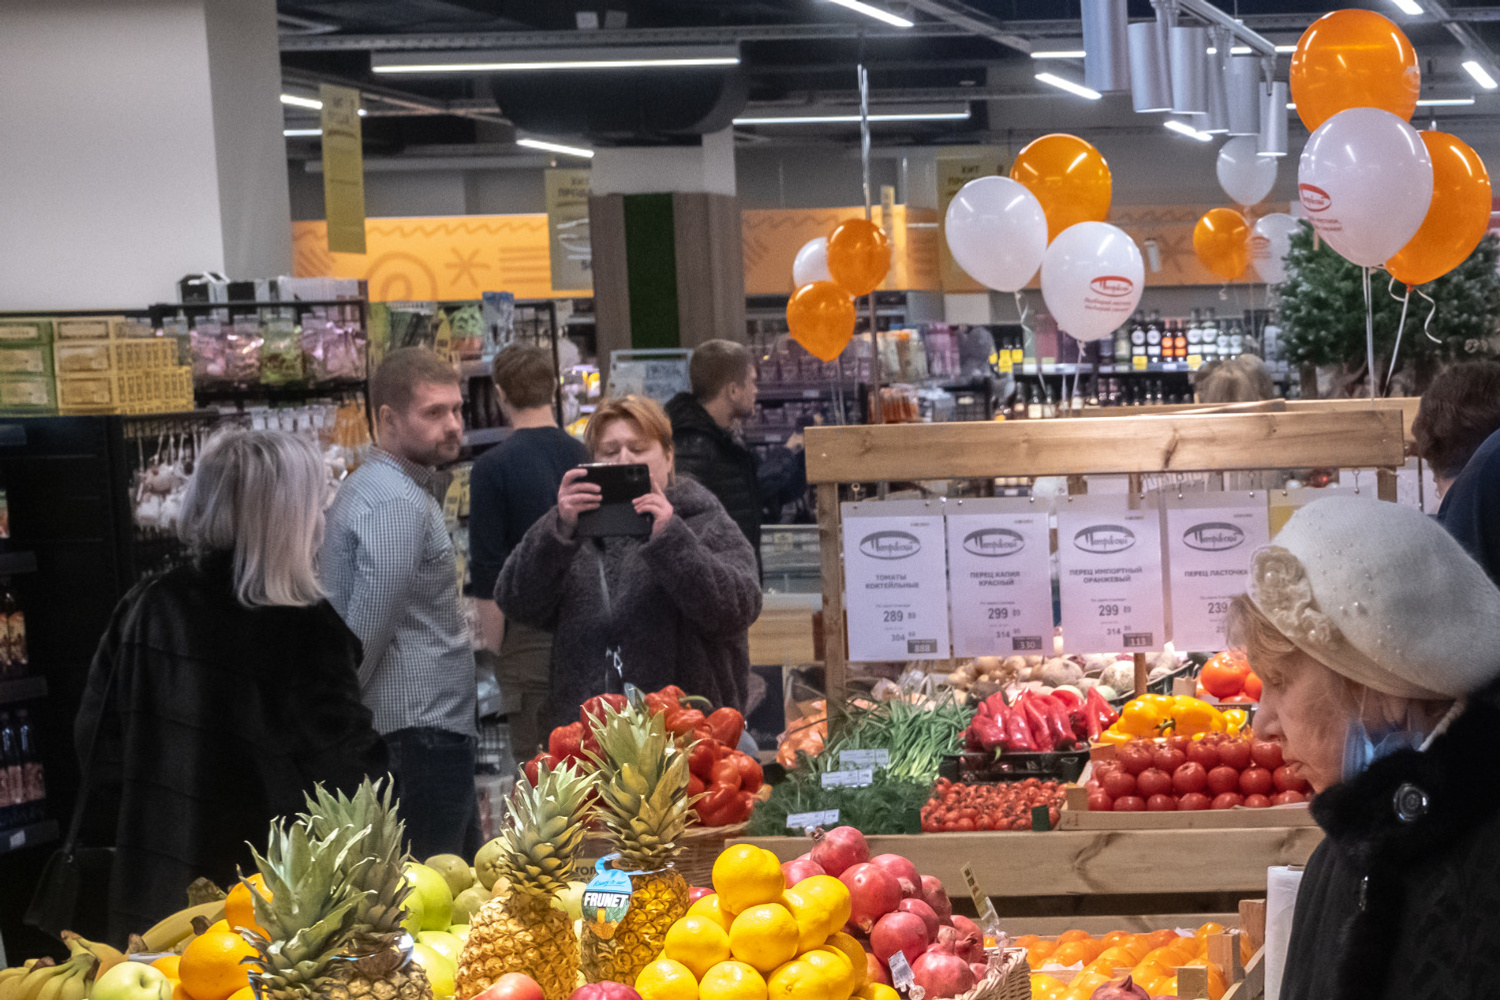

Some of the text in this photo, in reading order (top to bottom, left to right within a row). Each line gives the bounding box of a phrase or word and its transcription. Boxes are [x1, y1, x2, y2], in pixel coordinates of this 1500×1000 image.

[1069, 567, 1142, 576] ПЕРЕЦ ИМПОРТНЫЙ
[1184, 570, 1210, 578] ПЕРЕЦ
[1083, 575, 1131, 583] ОРАНЖЕВЫЙ
[1098, 604, 1119, 616] 299
[1207, 601, 1228, 614] 239
[883, 610, 903, 622] 289
[988, 608, 1008, 619] 299
[584, 892, 629, 908] FRUNET
